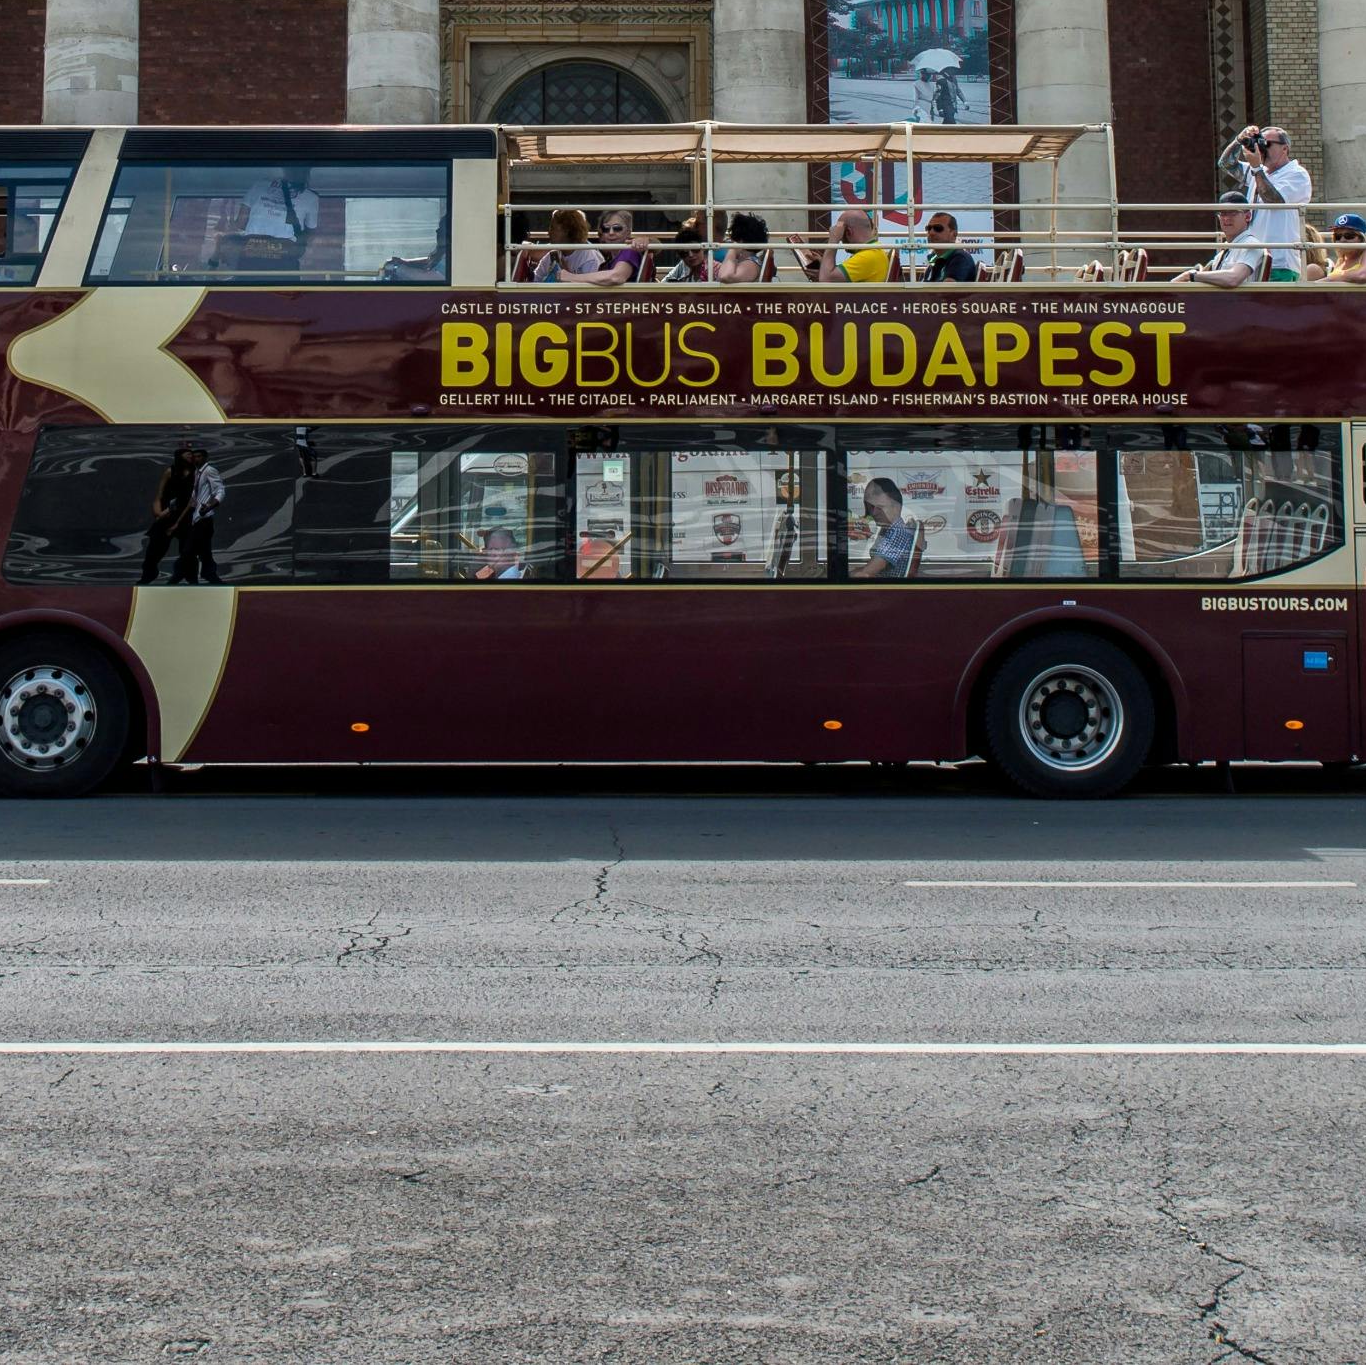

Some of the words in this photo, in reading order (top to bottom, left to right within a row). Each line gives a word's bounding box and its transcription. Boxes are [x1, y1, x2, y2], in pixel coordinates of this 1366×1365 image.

[442, 302, 493, 315] CASTLE
[499, 302, 560, 315] DISTRICT
[575, 302, 592, 315] ST
[597, 302, 673, 315] STEPHEN'S
[679, 302, 741, 315] BASILICA
[756, 302, 782, 315] THE
[788, 302, 831, 315] ROYAL
[836, 302, 887, 315] PALACE
[903, 302, 957, 315] HEROES
[962, 302, 1016, 315] SQUARE
[1031, 302, 1058, 315] THE
[1063, 302, 1098, 315] MAIN
[1103, 302, 1186, 315] SYNAGOGUE
[753, 321, 1186, 387] BUDAPEST
[440, 393, 499, 406] GELLERT
[505, 393, 535, 406] HILL
[549, 393, 574, 406] THE
[580, 393, 636, 406] CITADEL
[650, 393, 736, 406] PARLIAMENT
[751, 393, 824, 406] MARGARET
[830, 393, 878, 406] ISLAND
[893, 393, 985, 406] FISHERMAN'S
[991, 393, 1048, 406] BASTION
[1062, 393, 1088, 406] THE
[1094, 393, 1138, 406] OPERA
[1143, 393, 1188, 406] HOUSE
[965, 485, 1000, 496] Estrella
[1201, 597, 1348, 612] BIGBUSTOURS.COM
